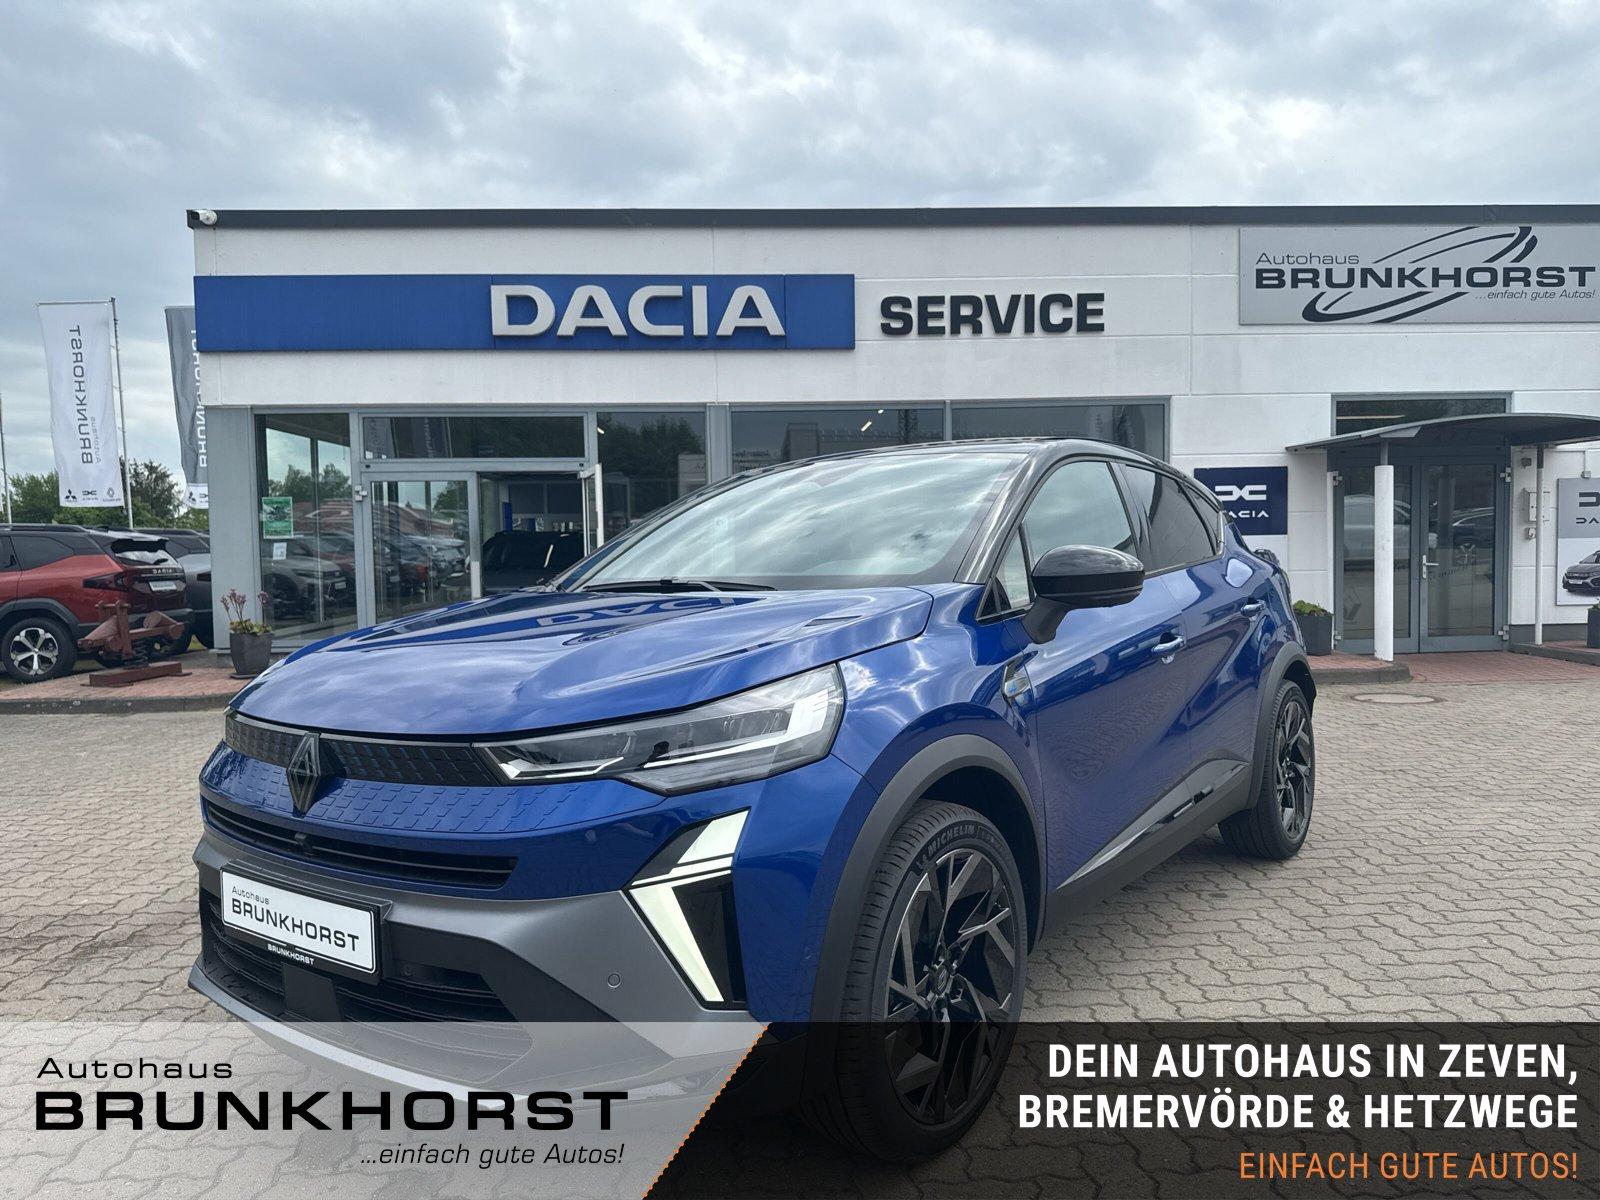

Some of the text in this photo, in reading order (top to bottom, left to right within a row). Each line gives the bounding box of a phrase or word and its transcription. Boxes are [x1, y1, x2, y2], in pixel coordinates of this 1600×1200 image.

[1256, 252, 1360, 265] Autohaus
[1255, 266, 1596, 289] BRUNKHORST
[1530, 290, 1557, 302] gute
[1559, 288, 1596, 299] Autos!
[490, 284, 786, 336] DACIA
[880, 293, 1105, 336] SERVICE
[1227, 510, 1269, 518] ACIA
[927, 824, 975, 857] MICHELIN
[231, 885, 270, 906] Autohaus
[231, 897, 360, 952] BRUNKHORST
[267, 943, 315, 966] BRUNKHORST
